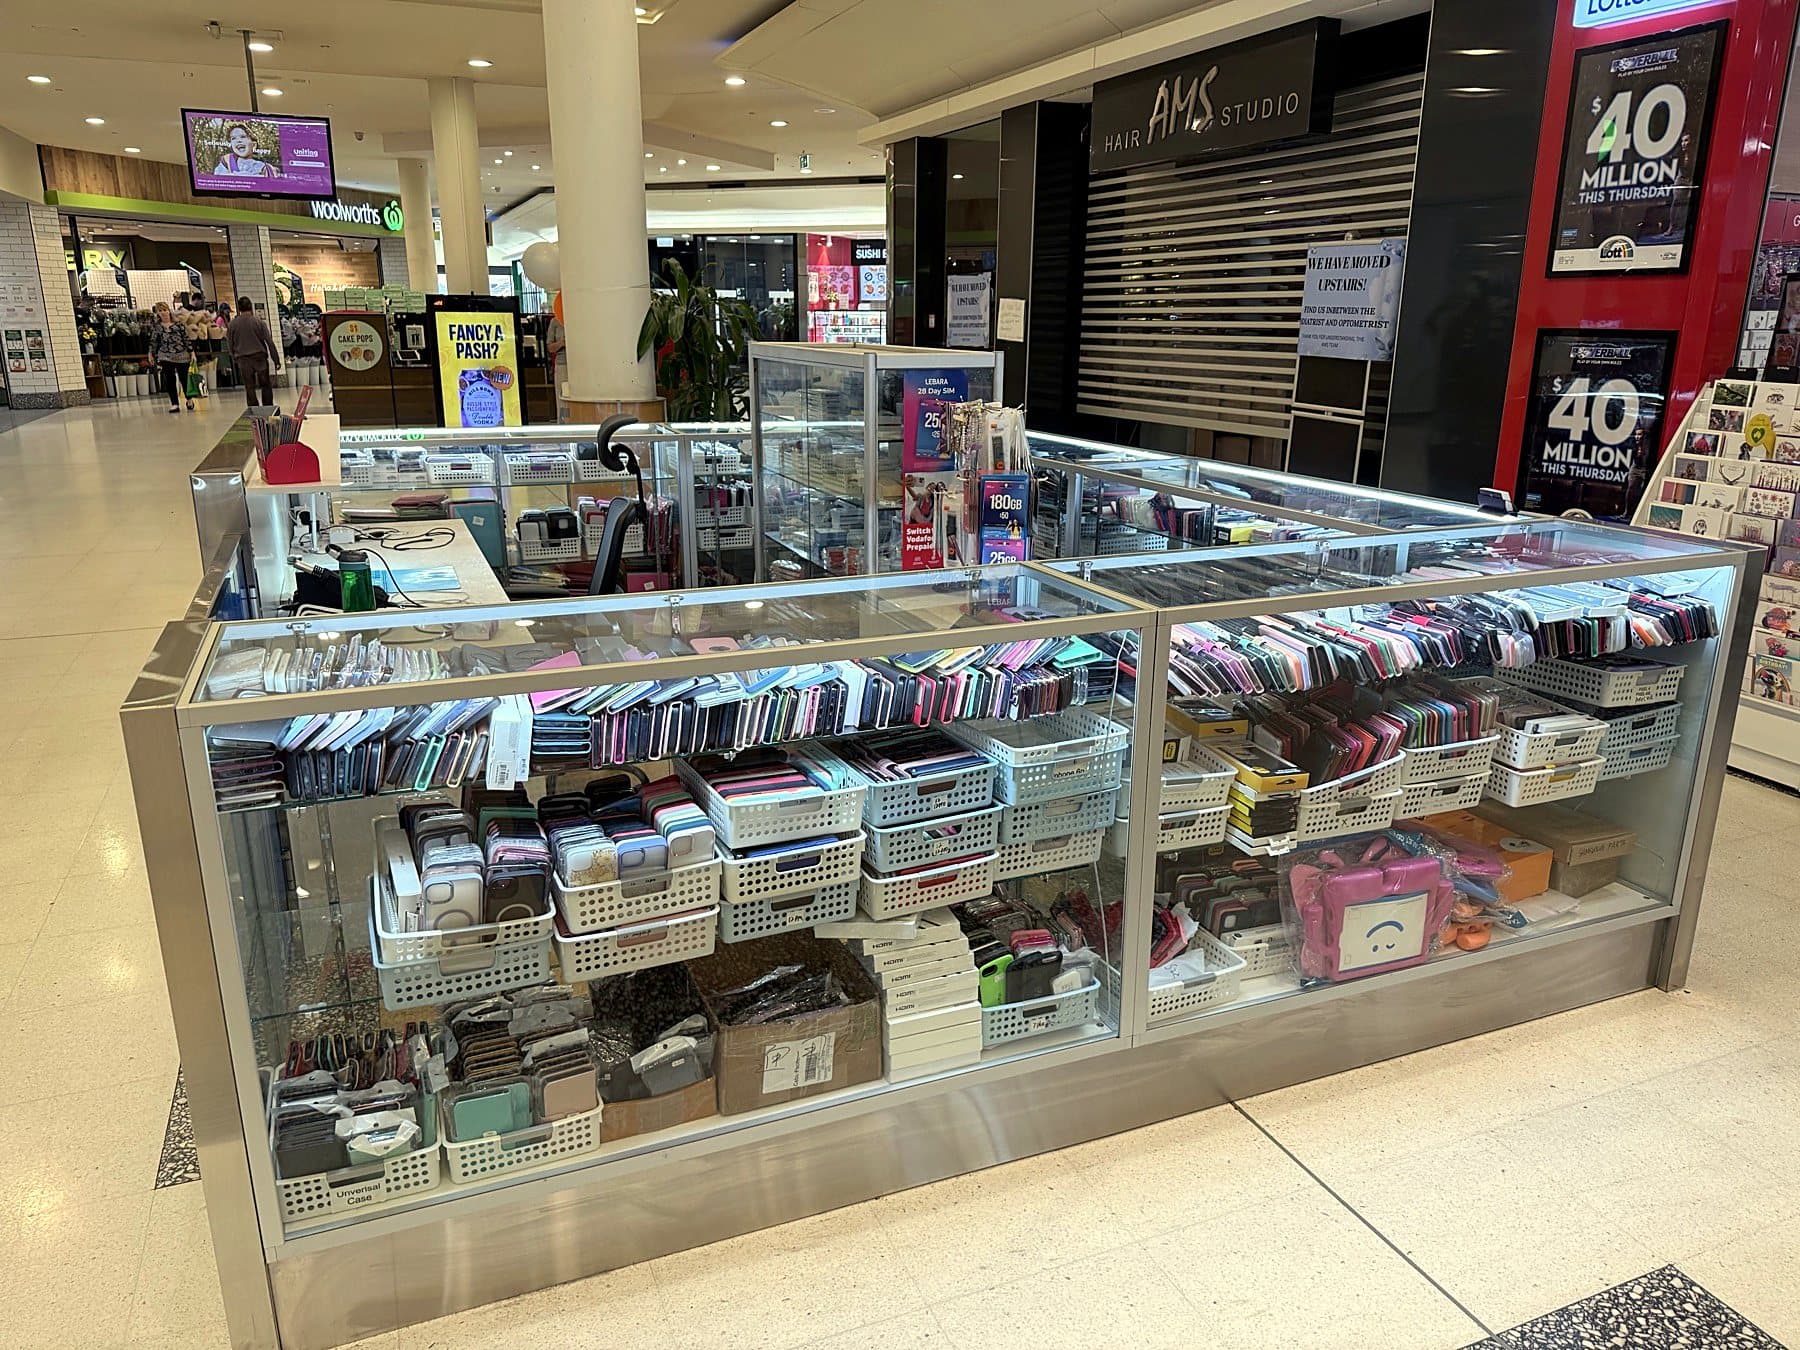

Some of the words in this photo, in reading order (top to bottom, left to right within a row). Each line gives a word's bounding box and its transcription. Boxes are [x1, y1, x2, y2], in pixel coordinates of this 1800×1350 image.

[1105, 129, 1140, 153] HAIR
[1147, 65, 1219, 144] AMS
[1220, 92, 1299, 126] STUDIO
[1580, 159, 1679, 190] MILLION
[1579, 190, 1604, 204] THIS
[1609, 184, 1671, 202] THURSDAY
[311, 199, 381, 225] Woolworths
[856, 249, 881, 259] SUSHI
[1308, 257, 1324, 270] WE
[1324, 256, 1352, 269] HAVE
[1352, 255, 1391, 269] MOVED
[1318, 278, 1368, 291] UPSTAIRS!
[1304, 306, 1317, 314] FIND
[1326, 306, 1360, 315] INBETWEEN
[1360, 307, 1376, 316] THE
[1325, 318, 1338, 327] AND
[1338, 319, 1390, 329] OPTOMETRIST
[337, 335, 354, 343] CAKE
[356, 334, 374, 343] POPS
[448, 324, 492, 341] FANCY
[495, 324, 504, 341] A
[456, 342, 499, 359] PASH?
[1570, 346, 1632, 360] POWERBALL
[492, 371, 511, 385] NEW
[917, 387, 927, 395] 28
[928, 387, 941, 396] Day
[924, 412, 941, 428] 25
[1543, 440, 1633, 469] MILLION
[1541, 462, 1566, 475] THIS
[1569, 465, 1628, 483] THURSDAY
[989, 494, 1022, 510] 180GB
[906, 527, 931, 535] Switch
[906, 535, 933, 543] Vodafo
[990, 551, 1017, 565] 25GB
[347, 1194, 372, 1205] Case
